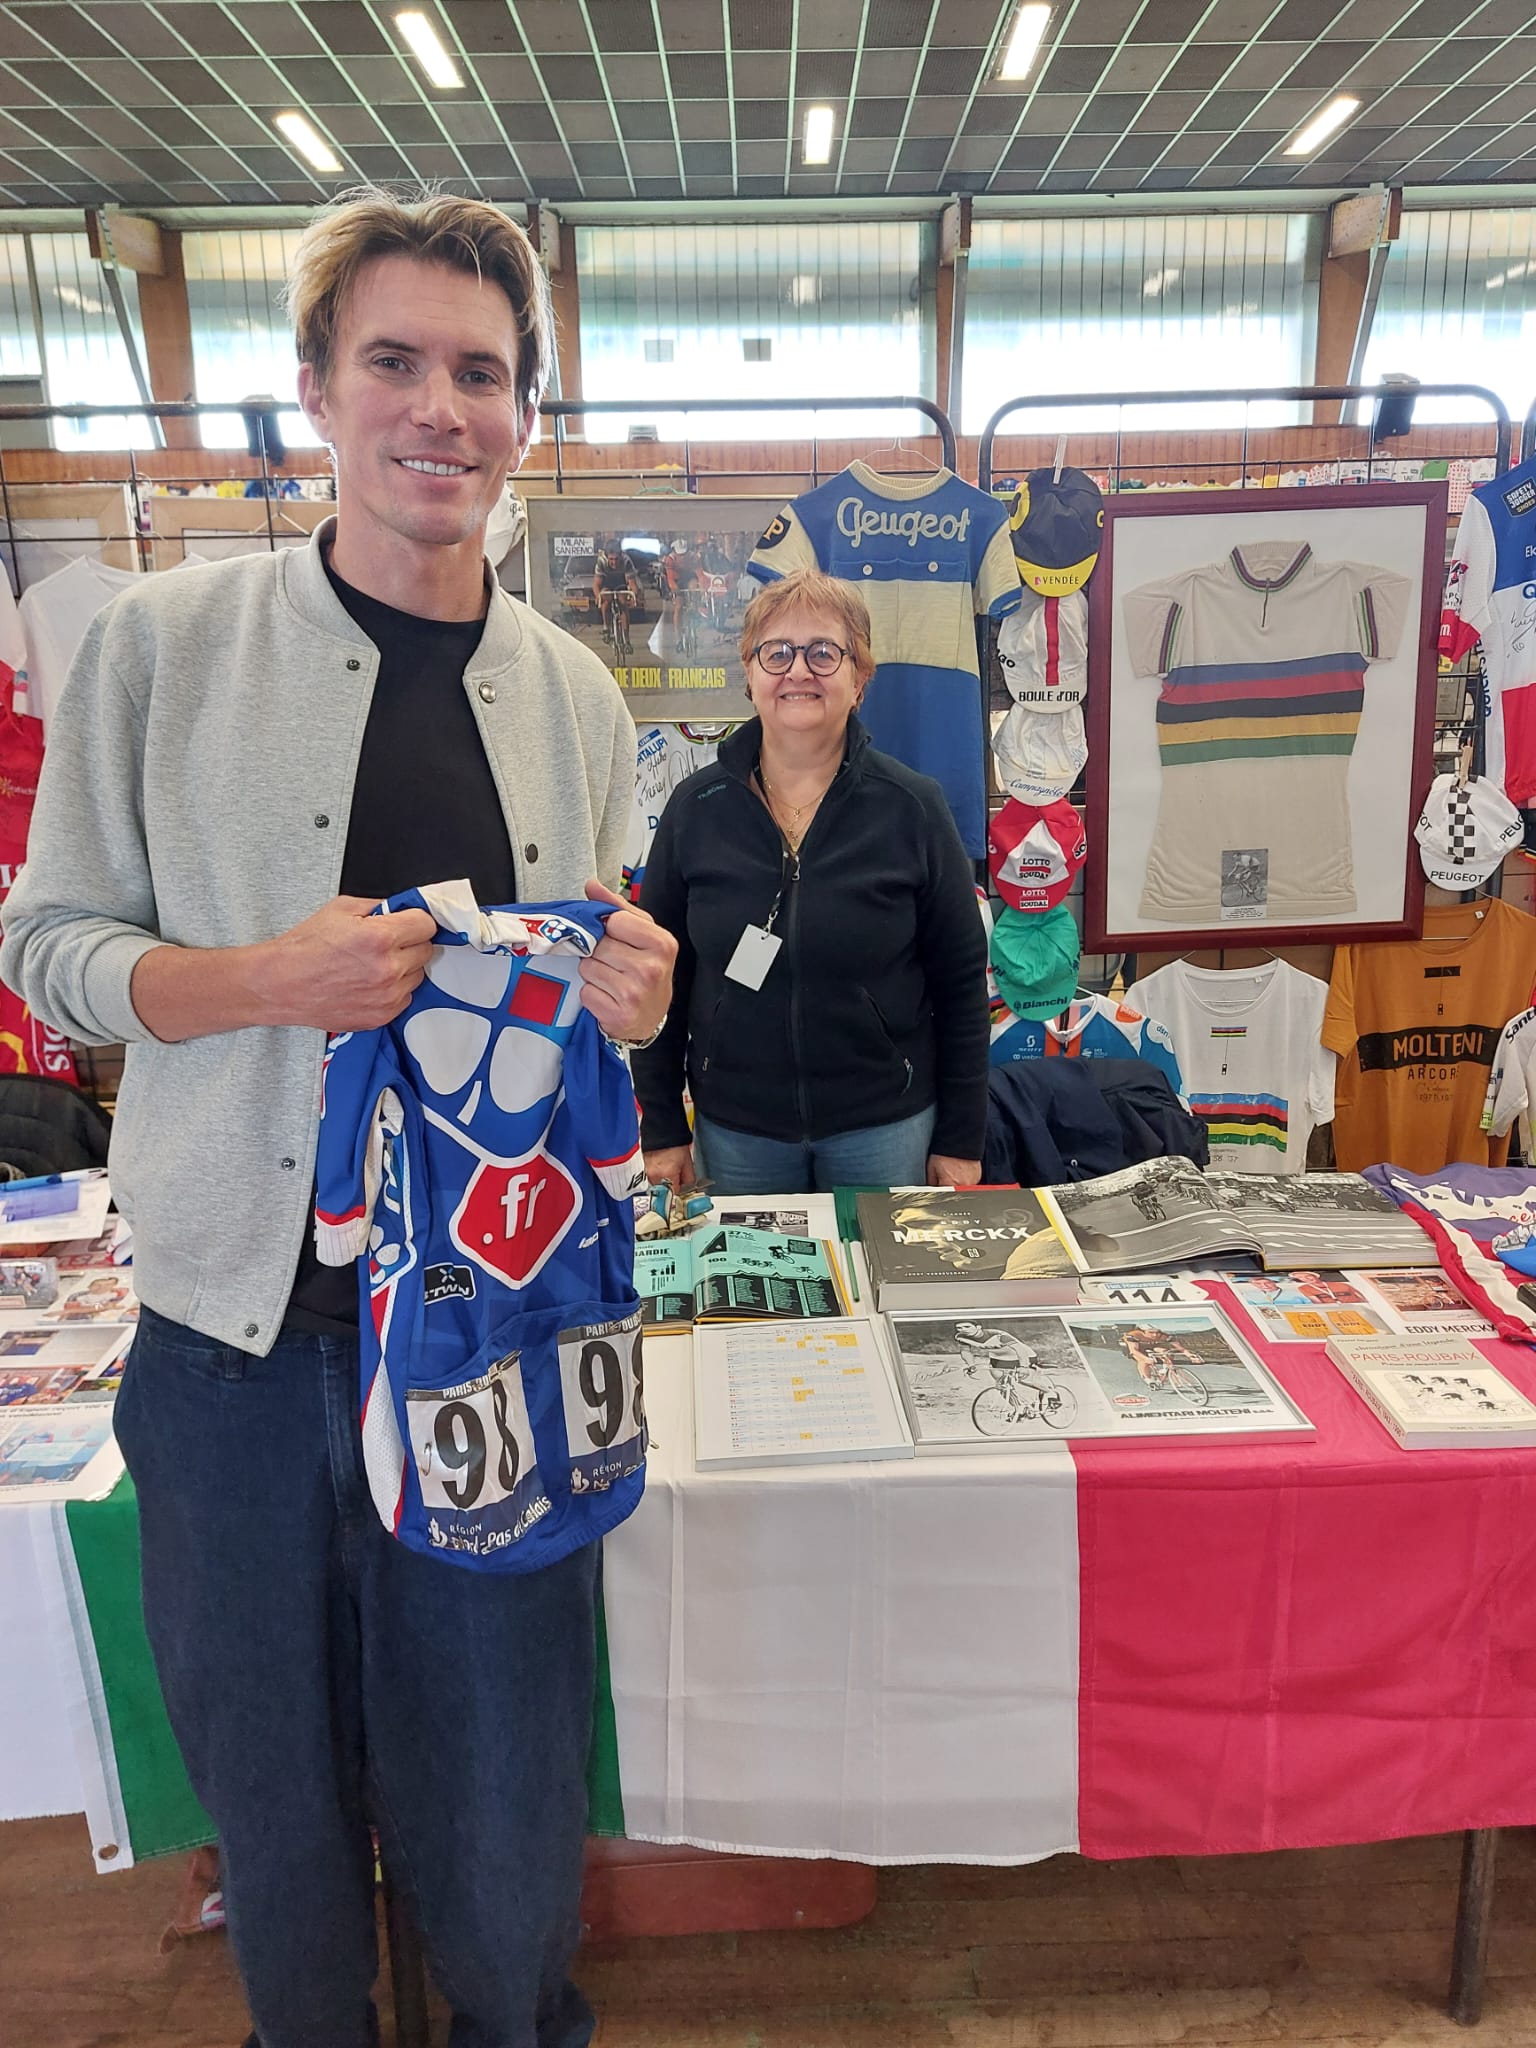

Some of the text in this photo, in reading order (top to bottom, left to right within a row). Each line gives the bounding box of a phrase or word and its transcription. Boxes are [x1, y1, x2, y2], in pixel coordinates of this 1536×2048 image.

[836, 496, 971, 547] Peugeot
[1042, 573, 1080, 586] VENDÉE
[632, 667, 661, 689] DEUX
[1018, 690, 1054, 703] BOULE
[1022, 858, 1051, 867] LOTTO
[1430, 870, 1485, 883] PEUGEOT
[1022, 889, 1046, 897] LOTTO
[1022, 996, 1068, 1010] Bianchi
[1393, 1031, 1484, 1062] MOLTENI
[482, 1173, 547, 1246] .fr
[890, 1226, 1033, 1244] MERCKX
[1405, 1324, 1497, 1335] EDDY MERCKX
[1350, 1351, 1481, 1361] PARIS-ROUBAIX
[1120, 1410, 1194, 1419] ALIMENTARI
[1196, 1408, 1251, 1417] MOLTENI
[434, 1378, 520, 1510] 98
